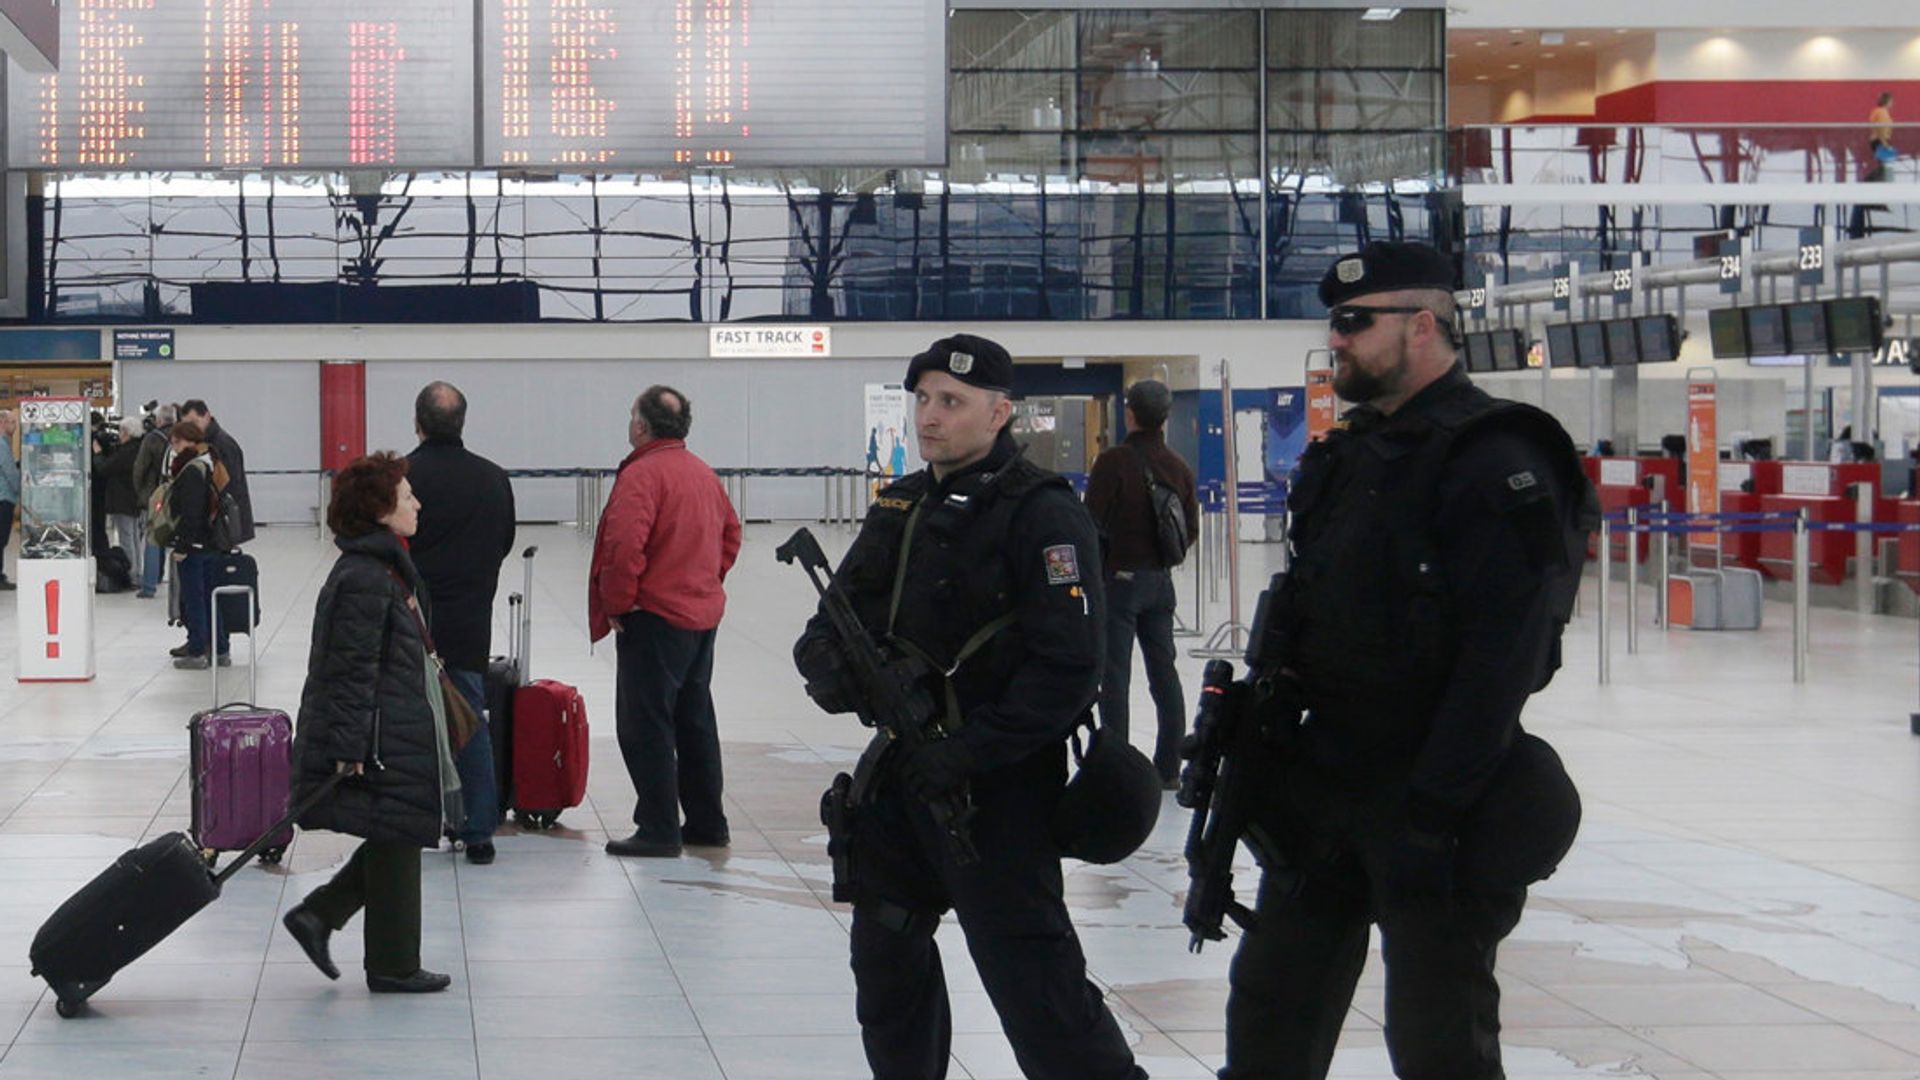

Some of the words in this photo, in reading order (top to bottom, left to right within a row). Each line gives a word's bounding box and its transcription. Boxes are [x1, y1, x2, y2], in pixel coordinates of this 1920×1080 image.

[1721, 255, 1741, 279] 234
[1800, 245, 1823, 270] 233
[1553, 277, 1569, 298] 236
[1613, 269, 1632, 291] 235
[1471, 288, 1485, 307] 237
[716, 330, 750, 343] FAST
[757, 330, 804, 343] TRACK
